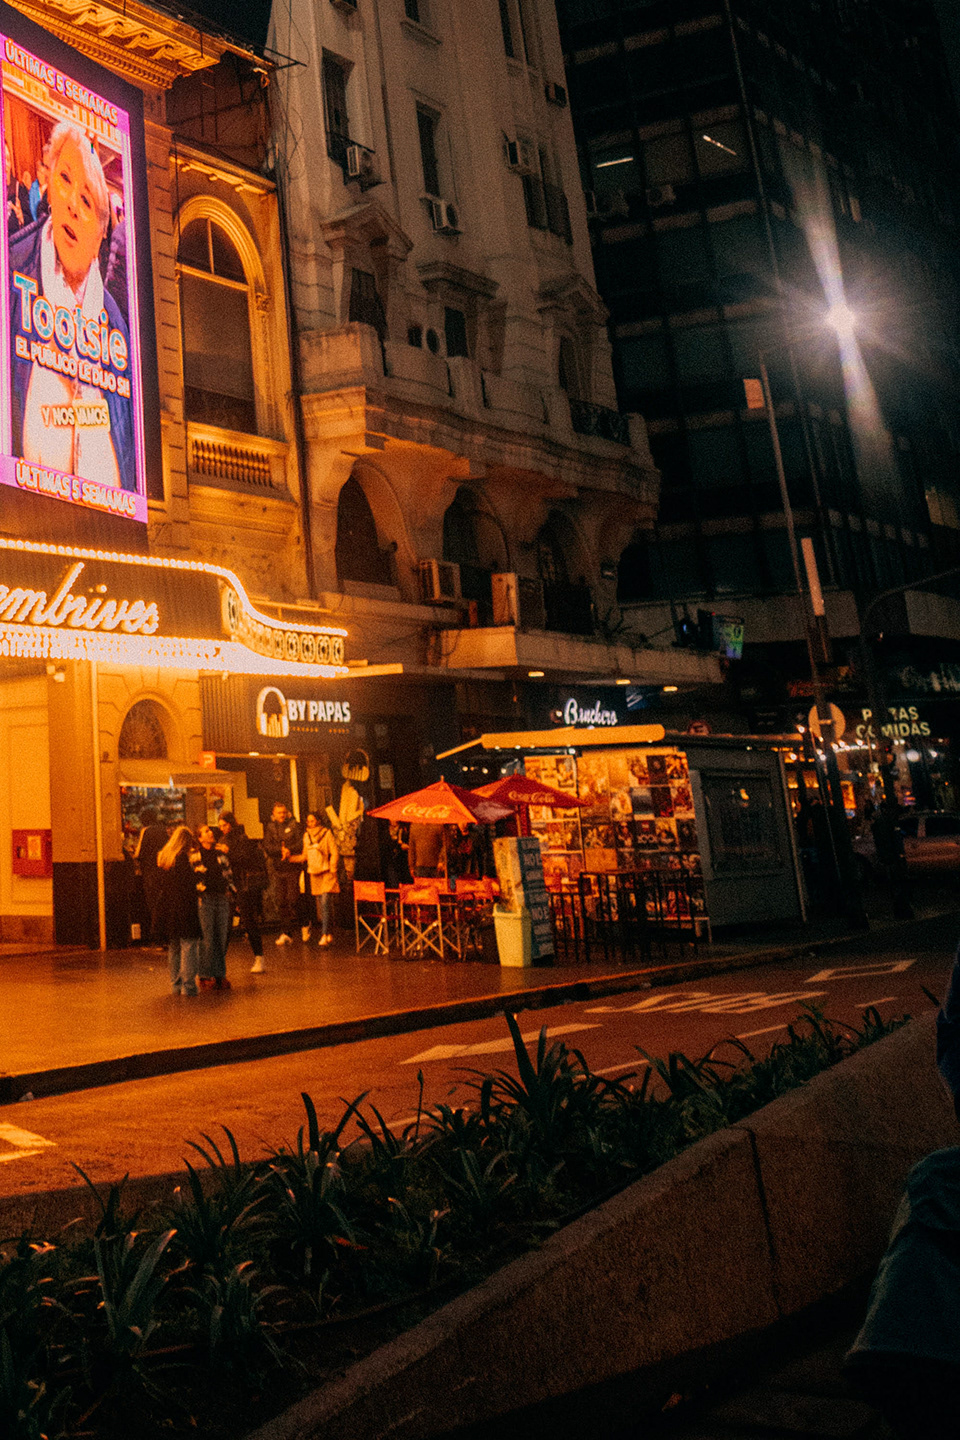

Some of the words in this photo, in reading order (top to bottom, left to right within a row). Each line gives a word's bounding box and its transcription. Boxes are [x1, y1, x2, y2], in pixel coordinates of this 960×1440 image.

[5, 38, 55, 88] ÚLTIMAS
[55, 74, 65, 93] 5
[65, 80, 119, 127] SEMANAS
[13, 271, 128, 371] Tootsie
[15, 334, 31, 360] EL
[78, 360, 92, 382] LE
[92, 367, 117, 393] DIJO
[41, 407, 50, 427] Y
[52, 406, 75, 427] NOS
[75, 406, 108, 427] VAMOS
[15, 460, 72, 498] ÚLTIMAS
[72, 478, 81, 501] 5
[81, 480, 137, 517] SEMANAS
[288, 699, 306, 721] BY
[307, 700, 351, 723] PAPAS
